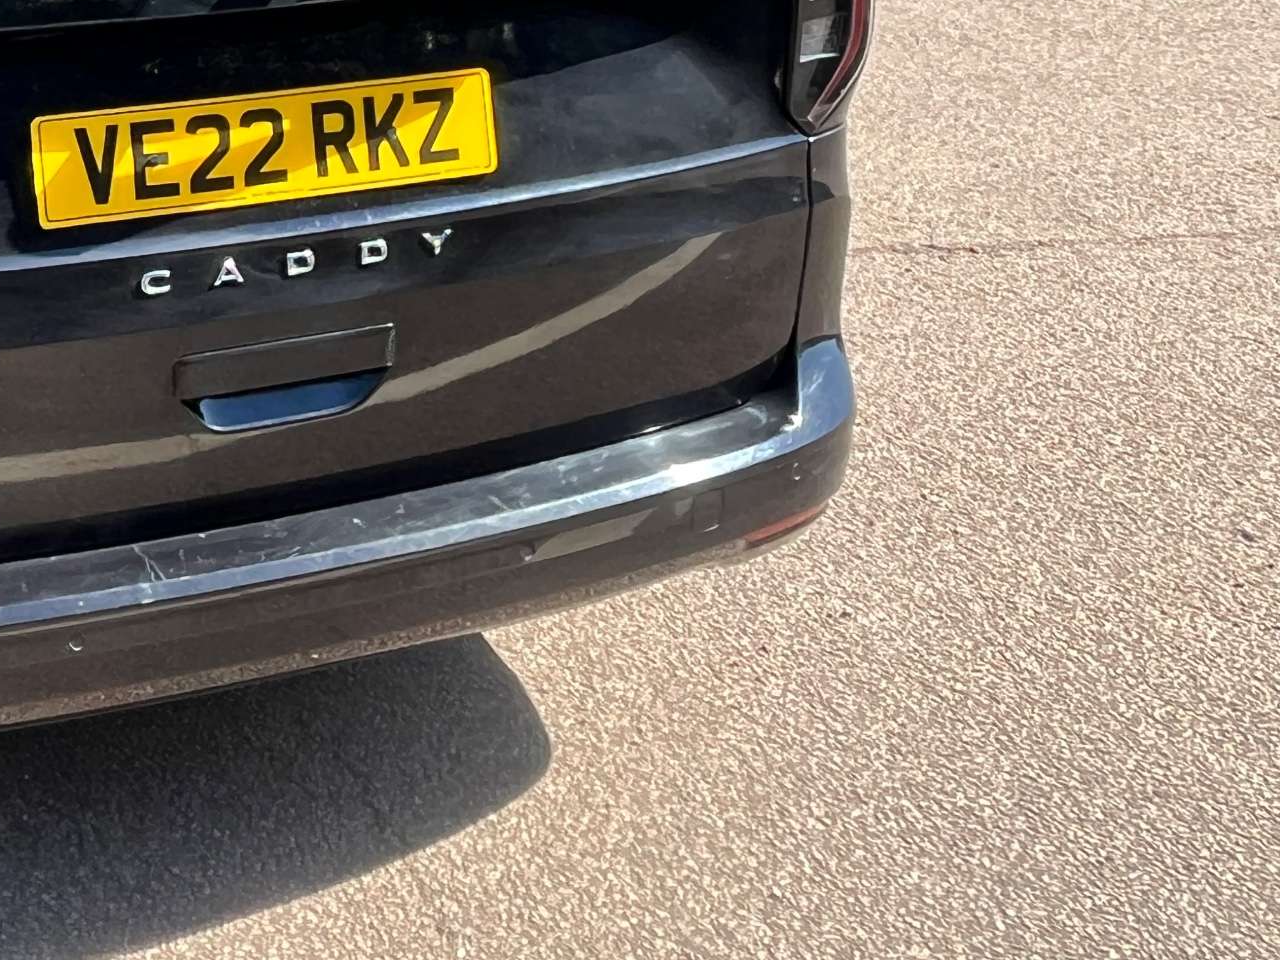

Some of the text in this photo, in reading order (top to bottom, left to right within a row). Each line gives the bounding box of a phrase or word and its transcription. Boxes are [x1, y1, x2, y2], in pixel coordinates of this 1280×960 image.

[74, 88, 460, 205] VE22 RKZ
[141, 229, 453, 295] CADDY
